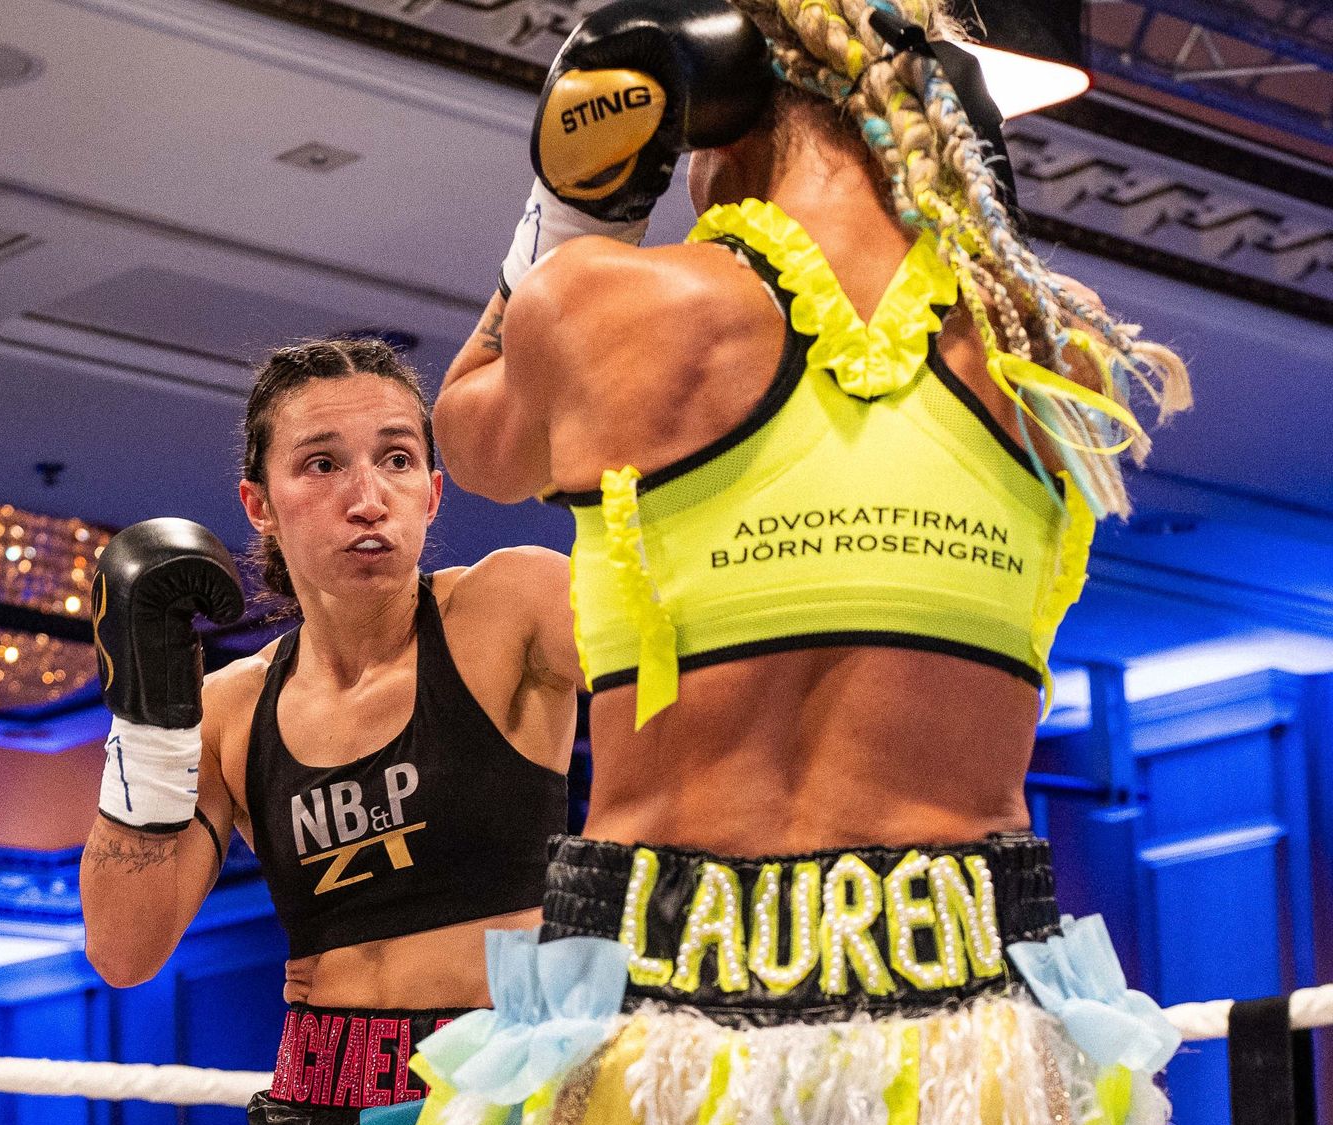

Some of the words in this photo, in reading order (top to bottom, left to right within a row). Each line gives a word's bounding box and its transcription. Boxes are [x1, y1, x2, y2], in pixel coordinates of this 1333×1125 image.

[561, 86, 651, 134] STING
[711, 537, 823, 569] BJÖRN
[834, 534, 1024, 575] ROSENGREN
[734, 506, 1009, 545] ADVOKATFIRMAN
[291, 761, 420, 857] NB&P
[300, 821, 427, 896] ZT
[619, 847, 1003, 996] LAUREN
